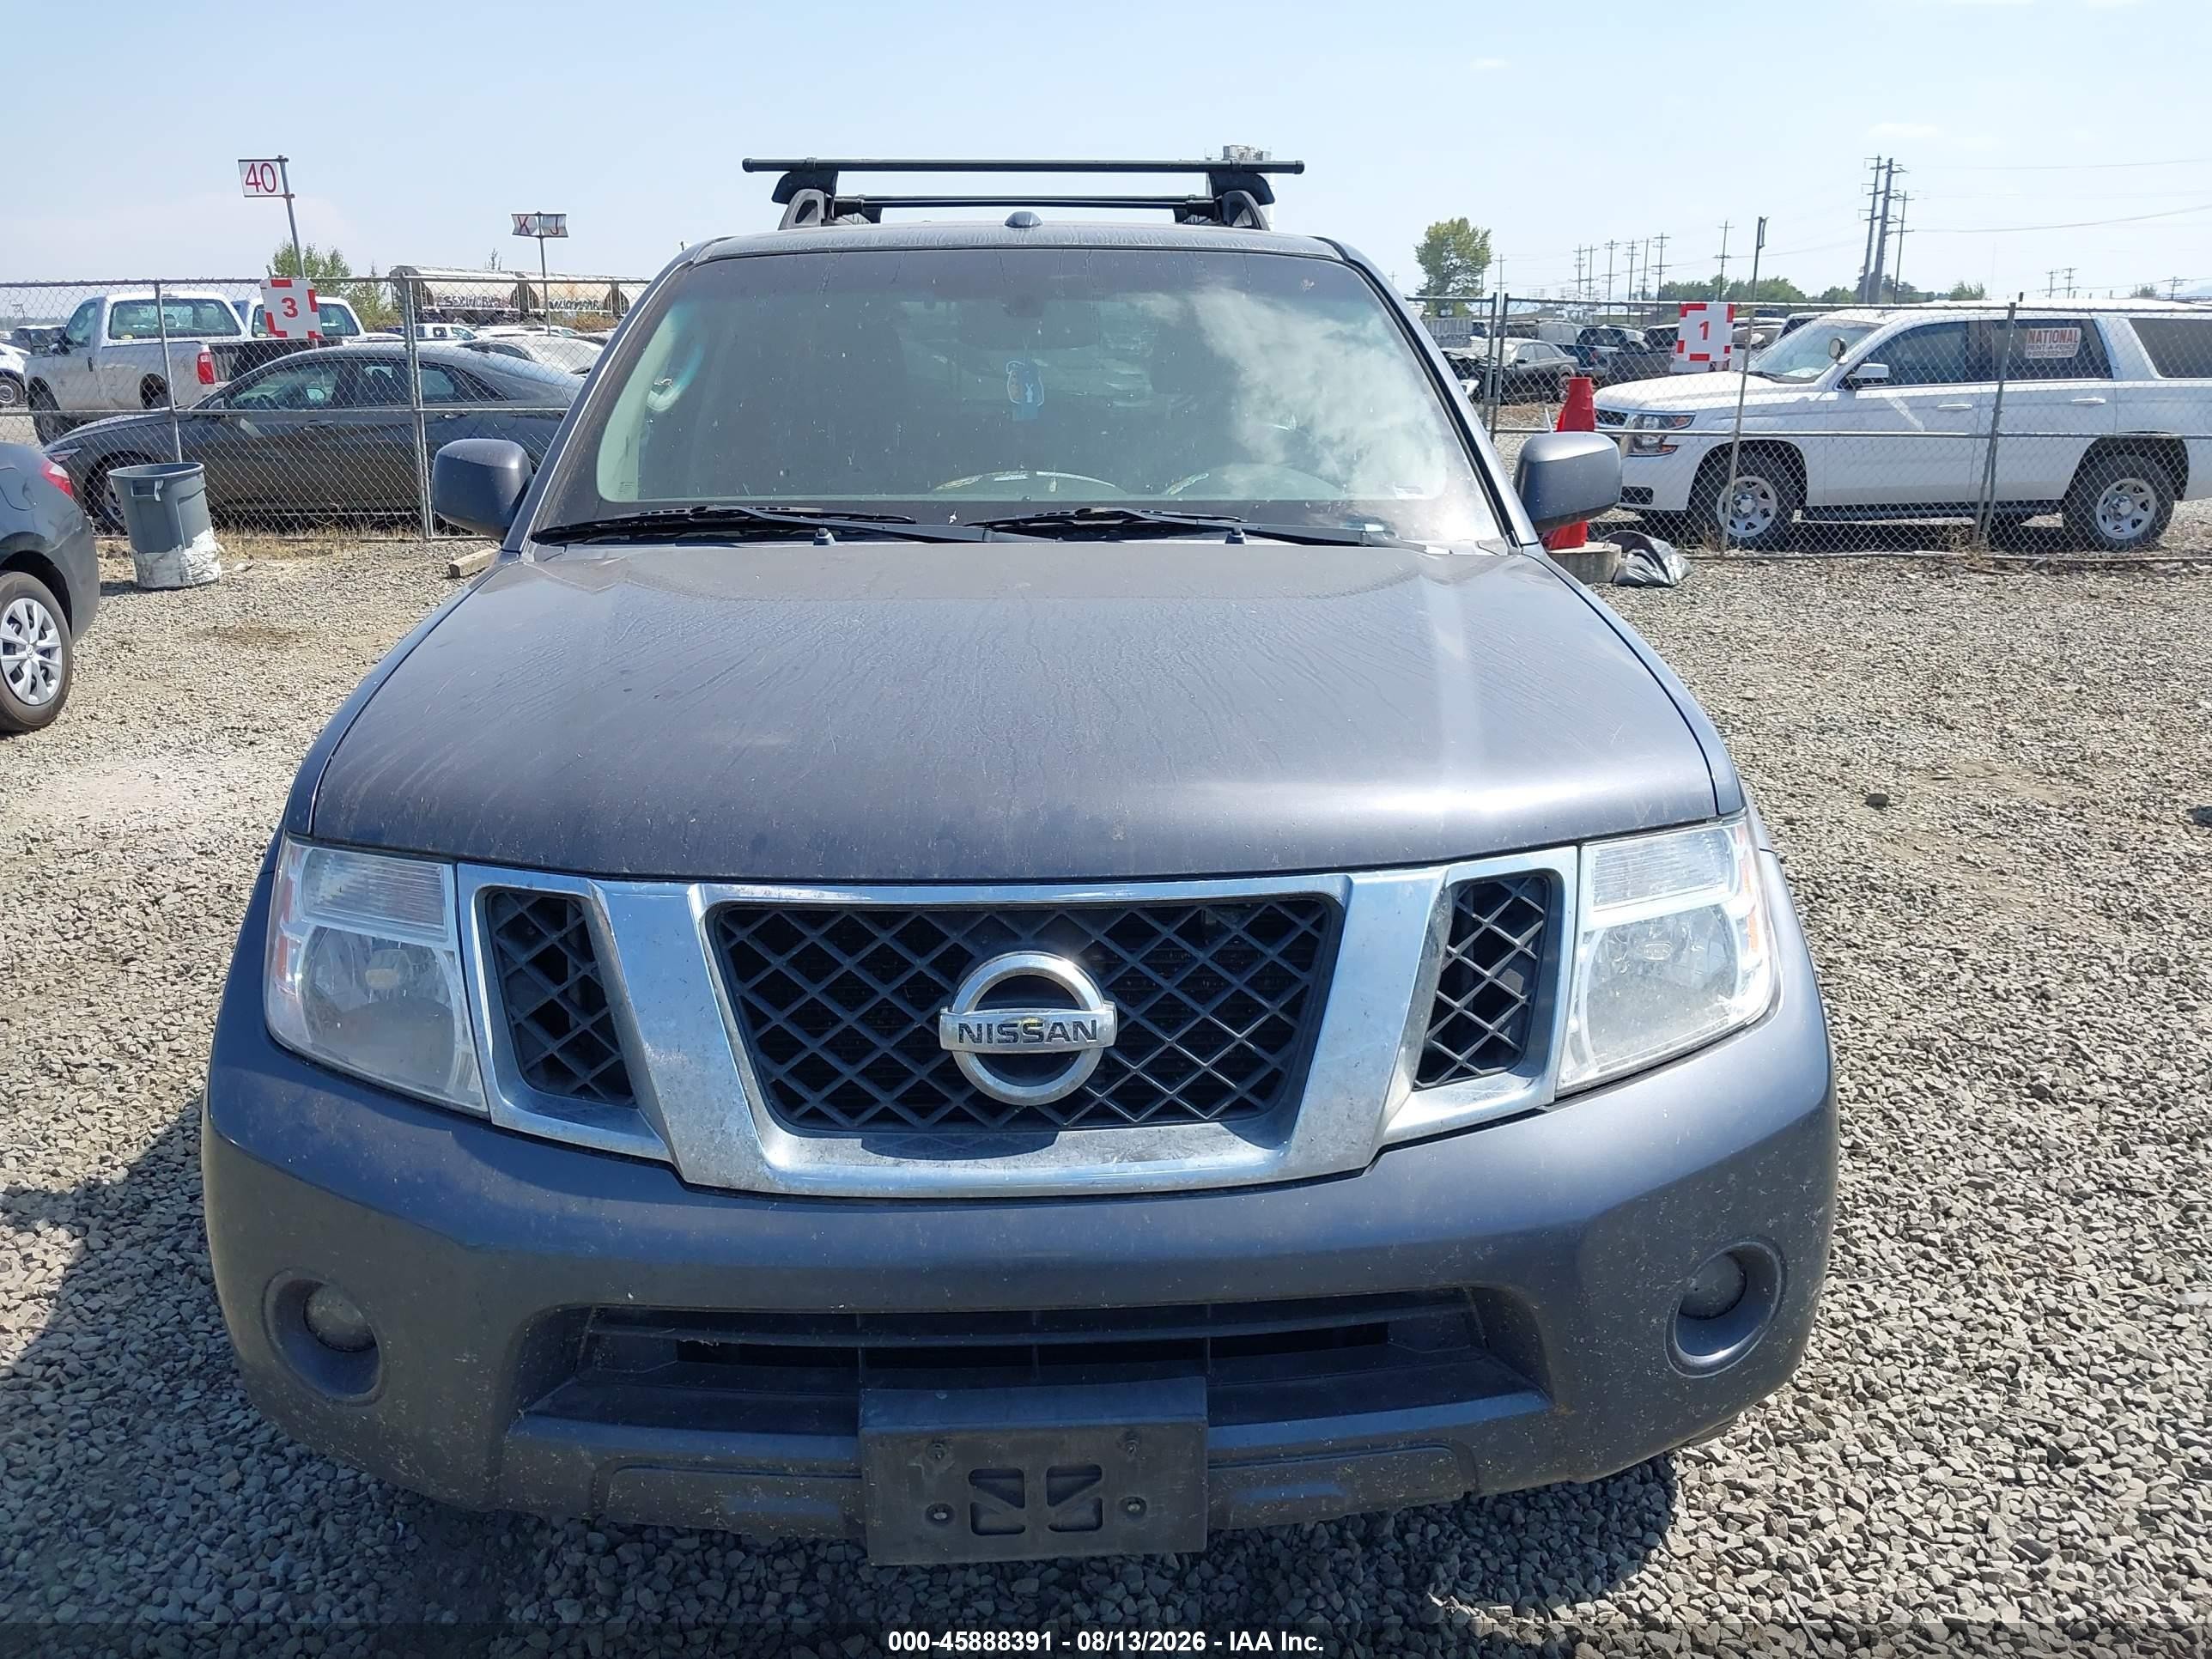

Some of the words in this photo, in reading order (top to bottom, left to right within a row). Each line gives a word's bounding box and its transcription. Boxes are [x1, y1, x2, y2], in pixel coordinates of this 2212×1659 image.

[245, 162, 276, 192] 40
[517, 215, 531, 235] K
[550, 216, 560, 235] J
[282, 297, 298, 318] 3
[1699, 321, 1710, 340] 1
[2028, 329, 2078, 343] NATIONAL
[957, 1018, 1097, 1043] NISSAN
